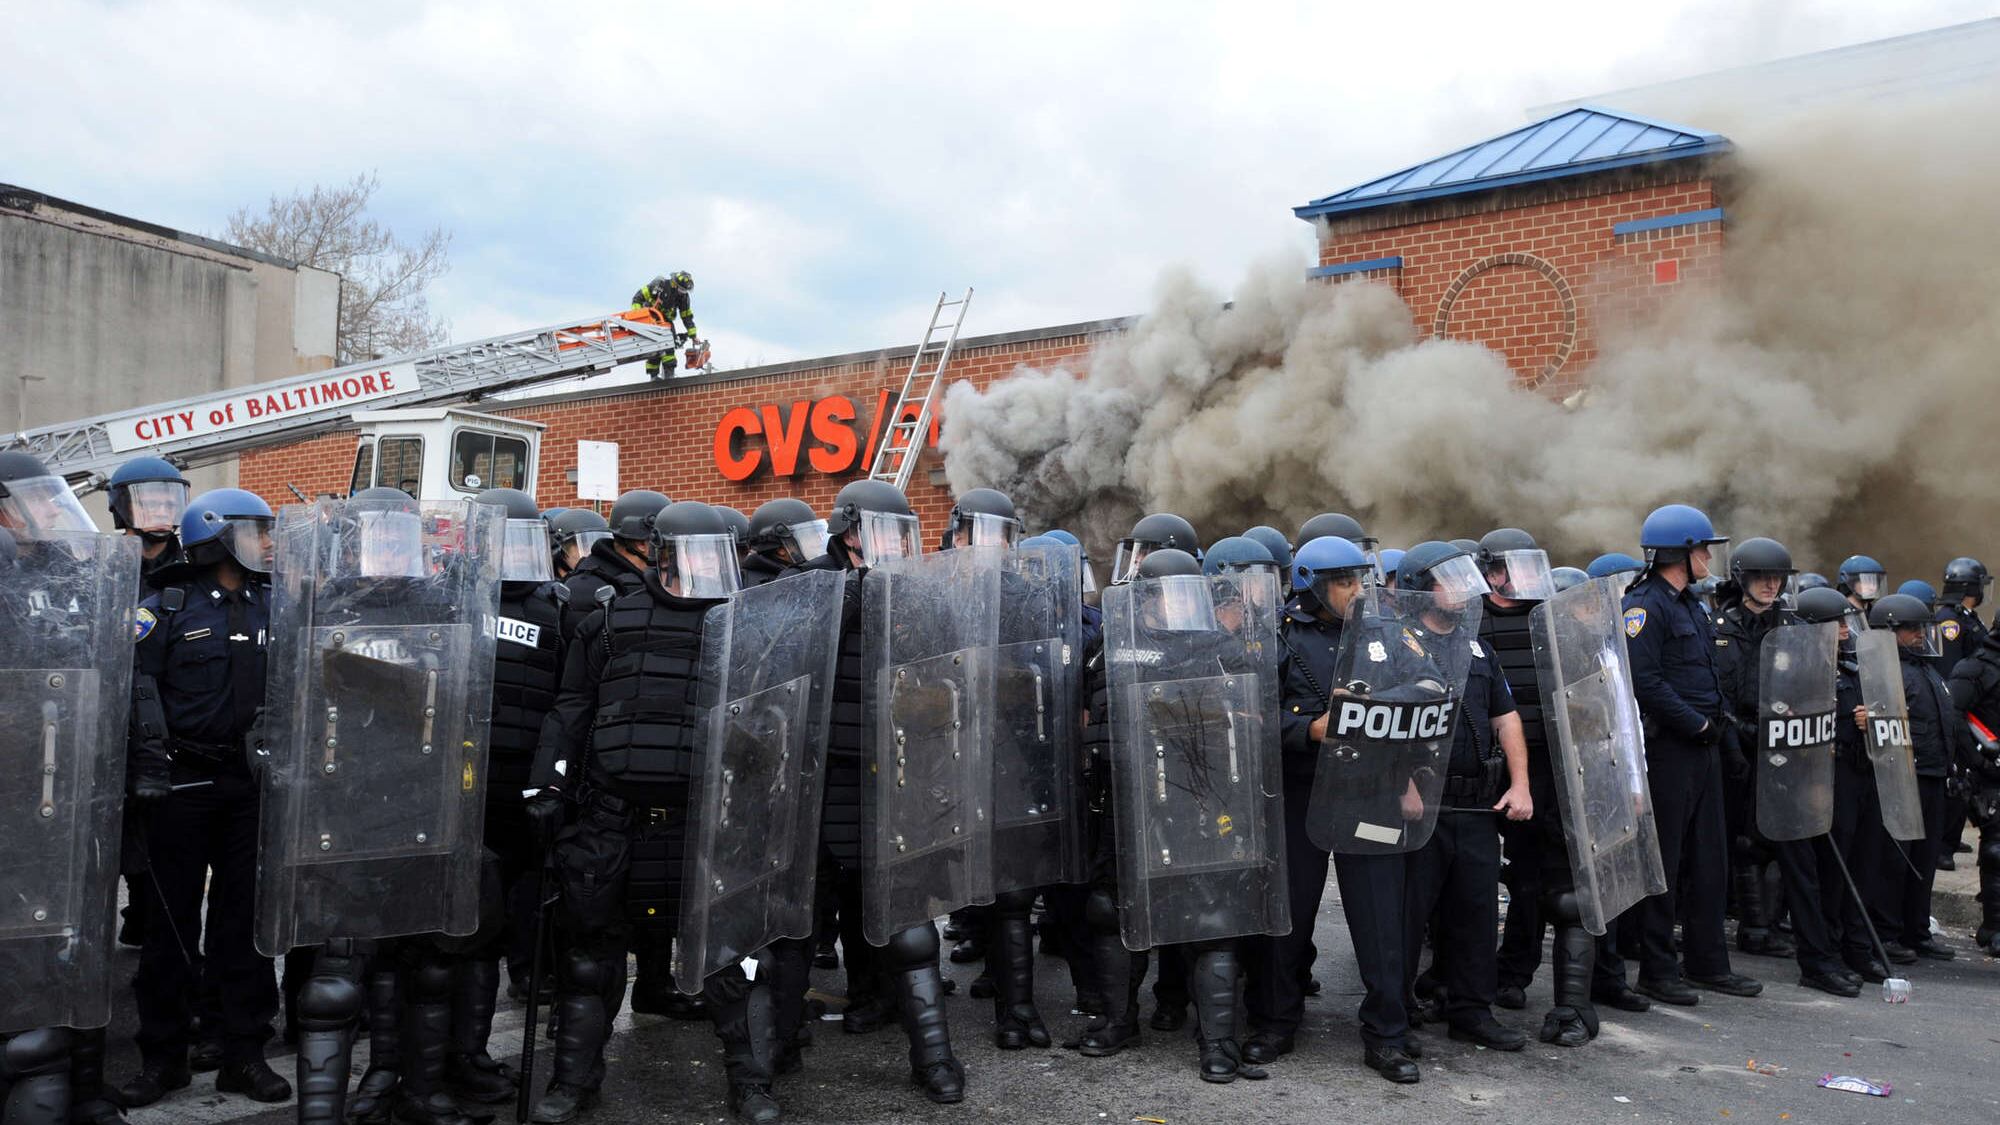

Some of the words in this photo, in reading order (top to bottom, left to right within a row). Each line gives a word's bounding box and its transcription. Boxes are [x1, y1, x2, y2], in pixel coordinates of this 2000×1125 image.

[135, 411, 194, 441] CITY
[209, 403, 233, 426] of
[246, 371, 395, 419] BALTIMORE
[1337, 701, 1454, 739] POLICE
